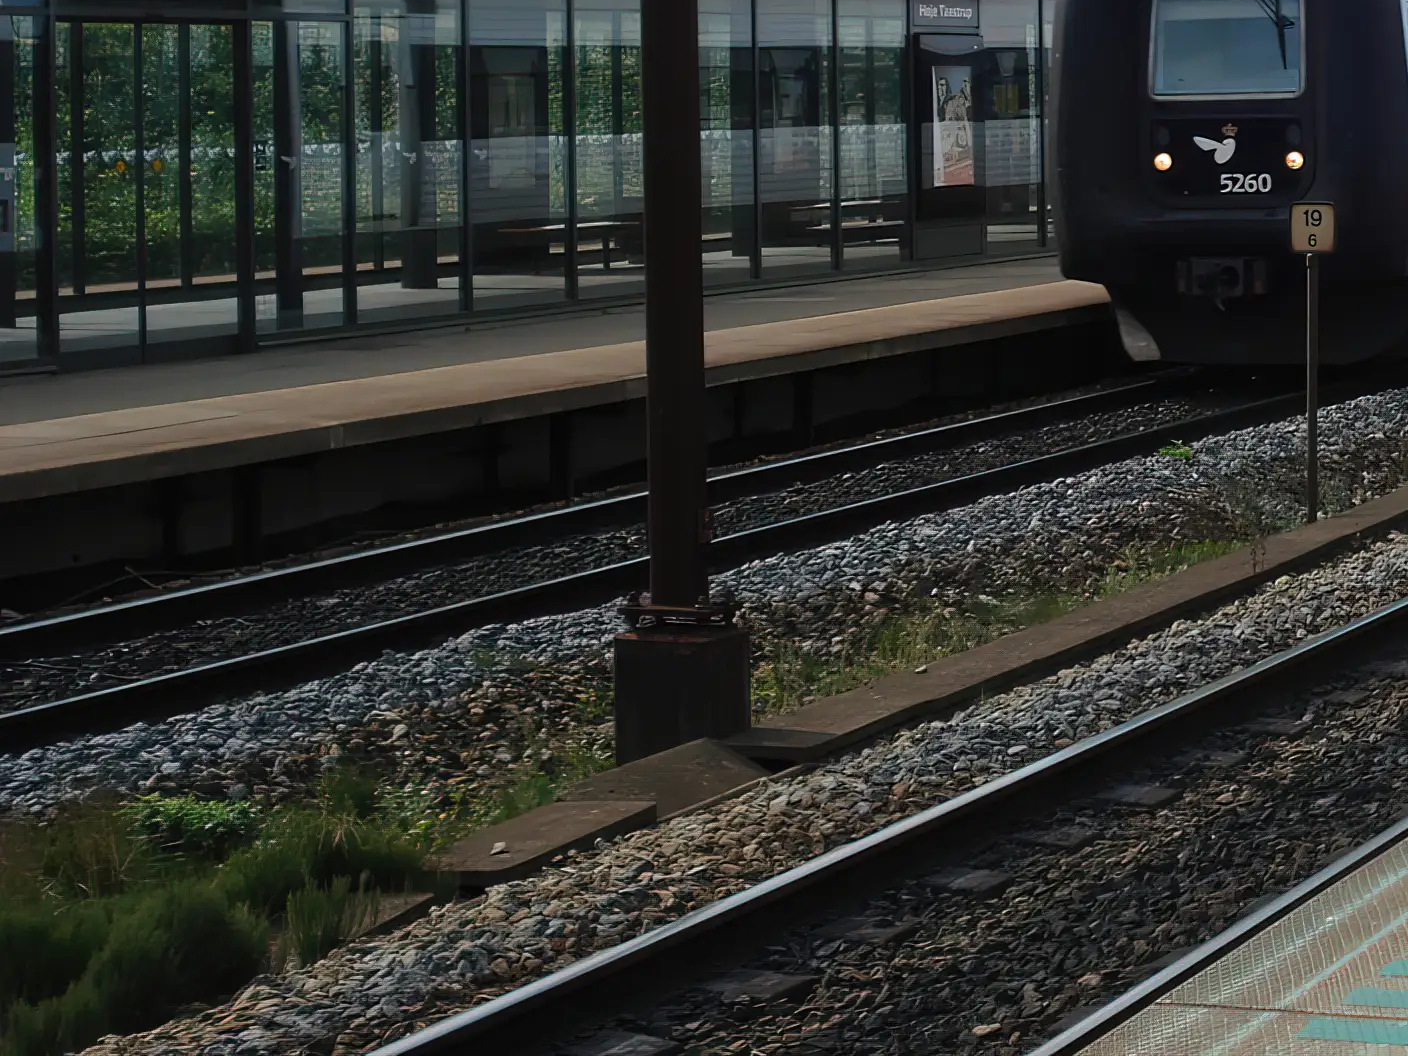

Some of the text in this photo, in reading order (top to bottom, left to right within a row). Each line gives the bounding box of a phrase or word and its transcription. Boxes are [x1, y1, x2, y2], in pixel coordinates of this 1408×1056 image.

[1220, 173, 1272, 193] 5260
[1303, 209, 1323, 228] 19
[1307, 233, 1318, 248] 6
